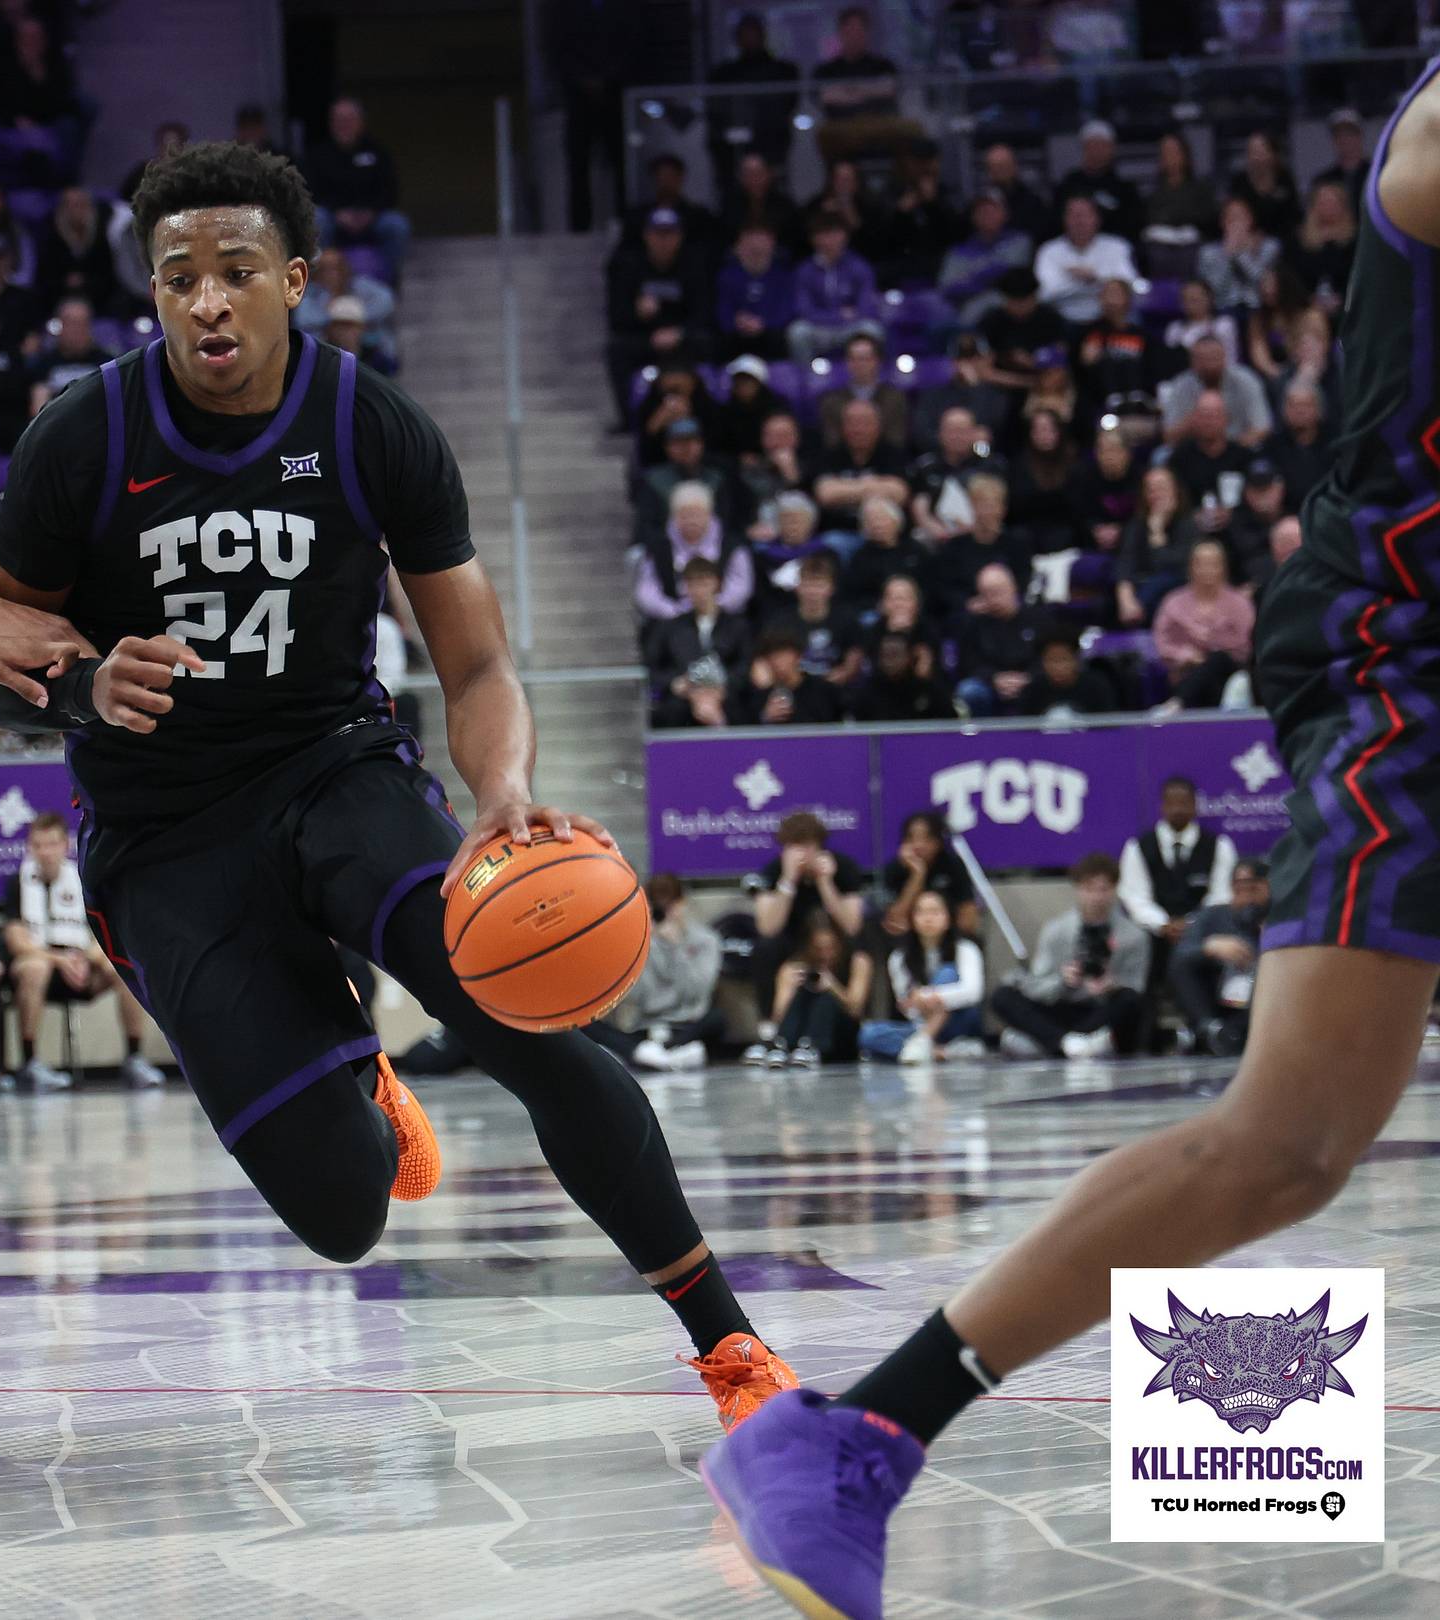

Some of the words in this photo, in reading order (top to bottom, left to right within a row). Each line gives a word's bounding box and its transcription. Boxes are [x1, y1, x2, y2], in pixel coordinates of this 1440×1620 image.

[280, 452, 322, 482] XII
[139, 509, 316, 588] TCU
[163, 589, 296, 679] 24
[930, 757, 1089, 835] TCU
